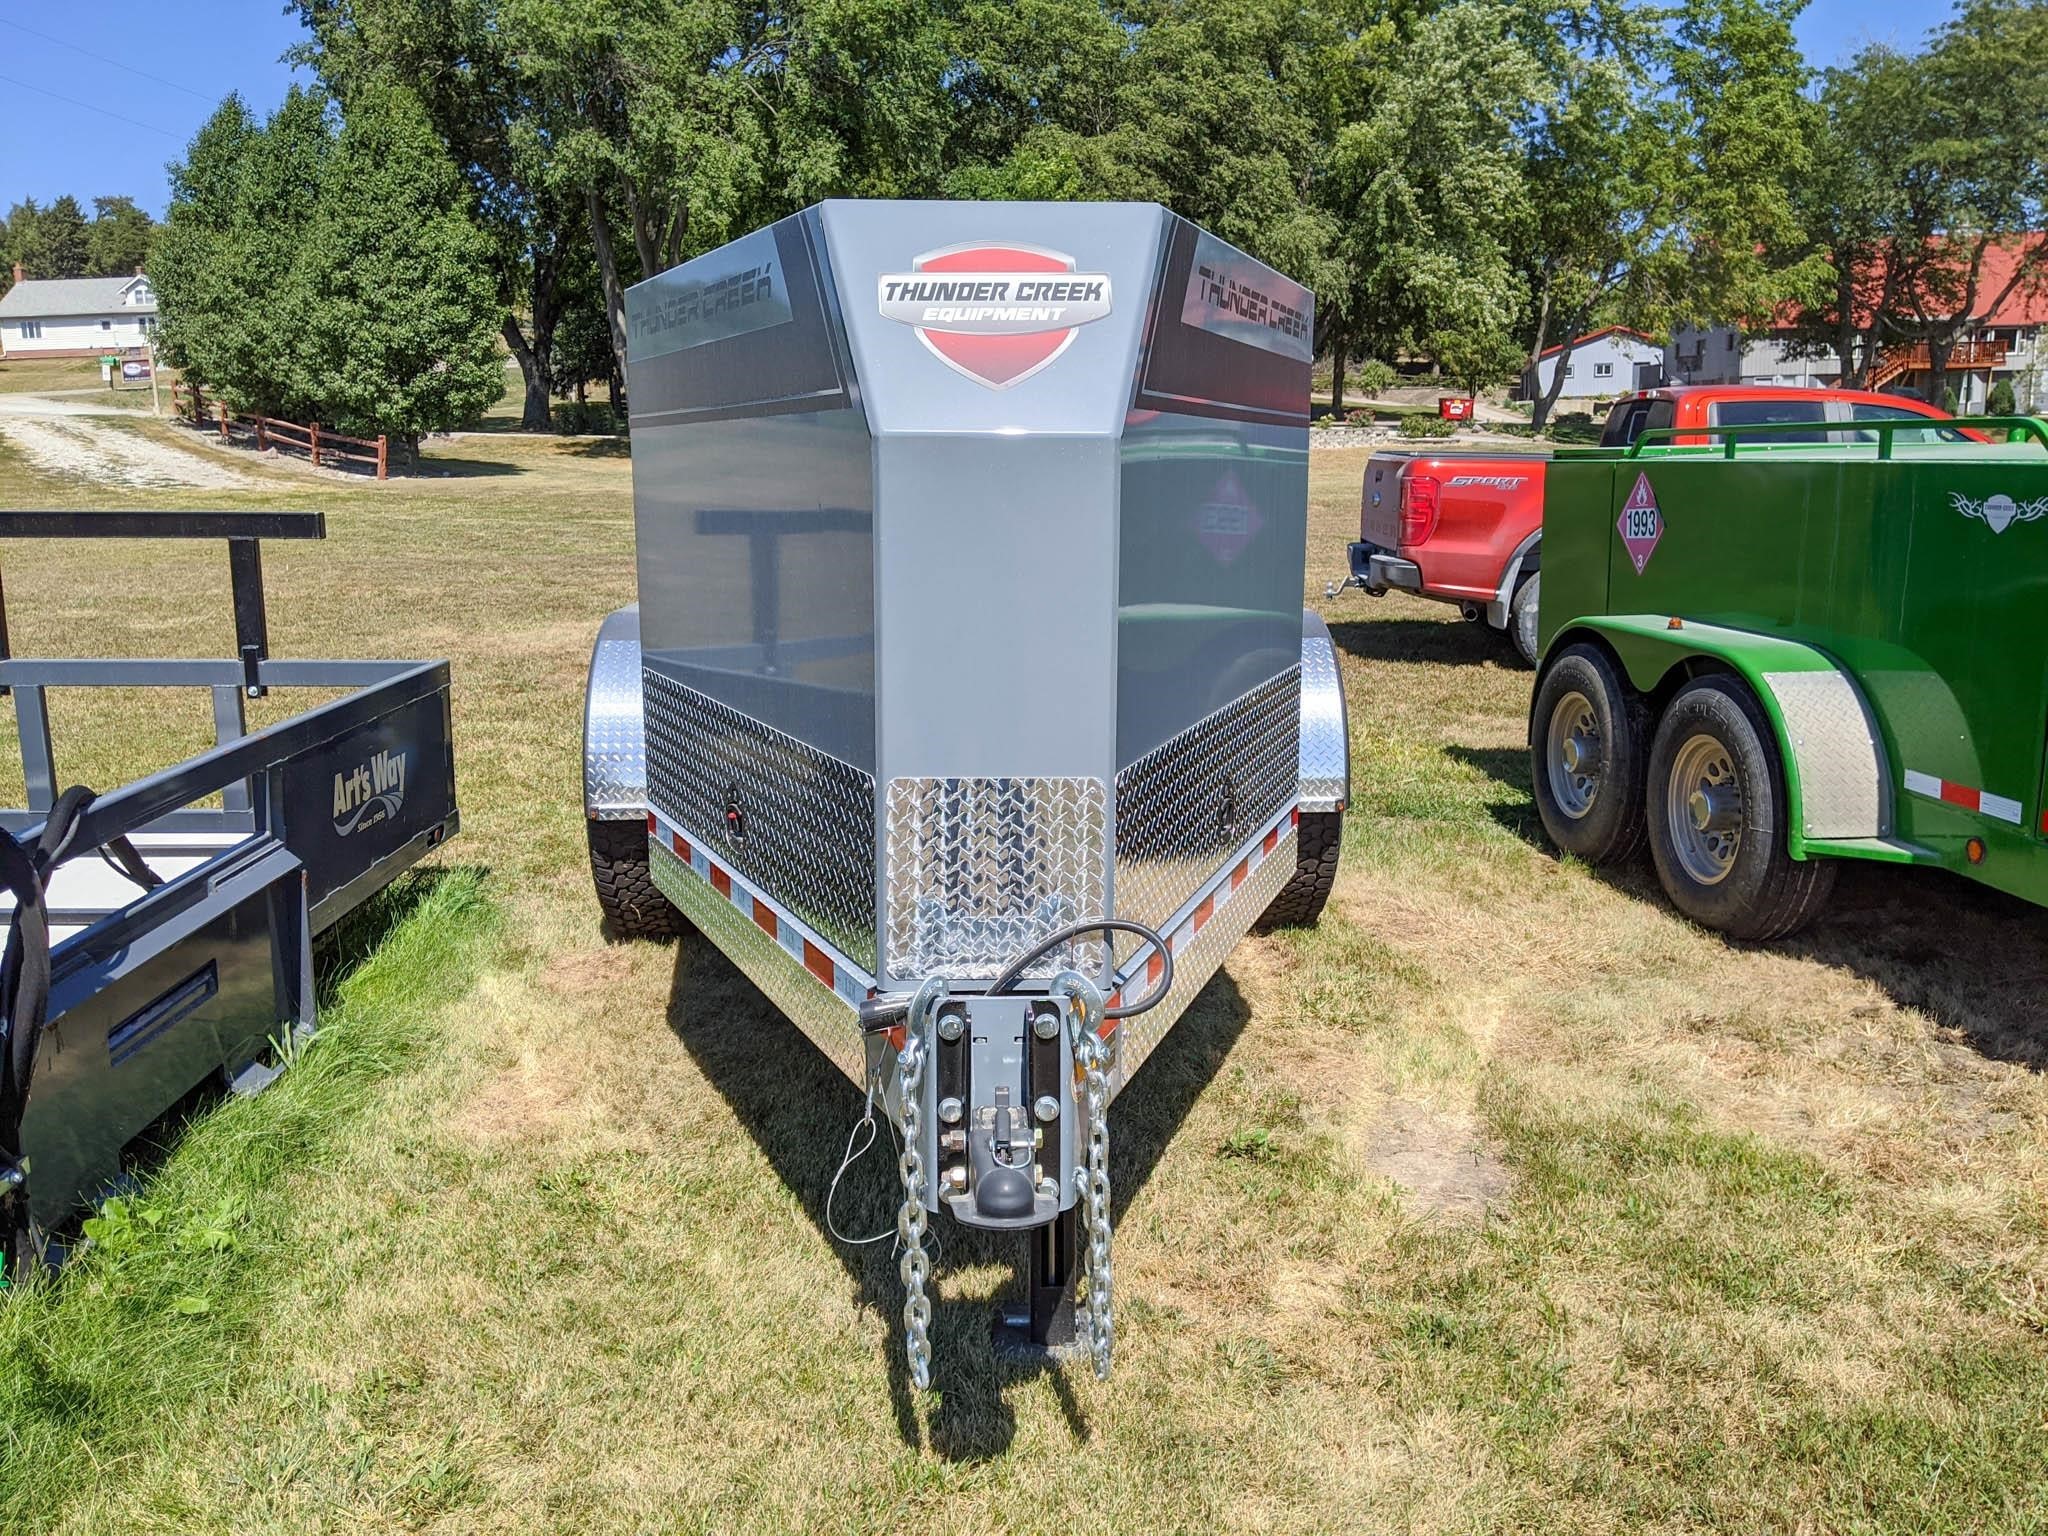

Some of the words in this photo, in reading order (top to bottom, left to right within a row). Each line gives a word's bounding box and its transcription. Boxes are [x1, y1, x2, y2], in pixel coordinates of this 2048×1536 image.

[631, 290, 700, 340] THUNDER
[703, 262, 772, 320] CREEK
[885, 282, 1010, 302] THUNDER
[1015, 282, 1104, 302] CREEK
[1198, 265, 1268, 325] THUNDER
[1269, 300, 1309, 340] CREEK
[922, 307, 1067, 323] EQUIPMENT
[1443, 476, 1529, 488] SPORT
[1627, 510, 1656, 537] 1993
[1637, 554, 1643, 567] 3
[333, 764, 371, 819] Art's
[371, 750, 406, 801] Way
[357, 819, 373, 832] Since
